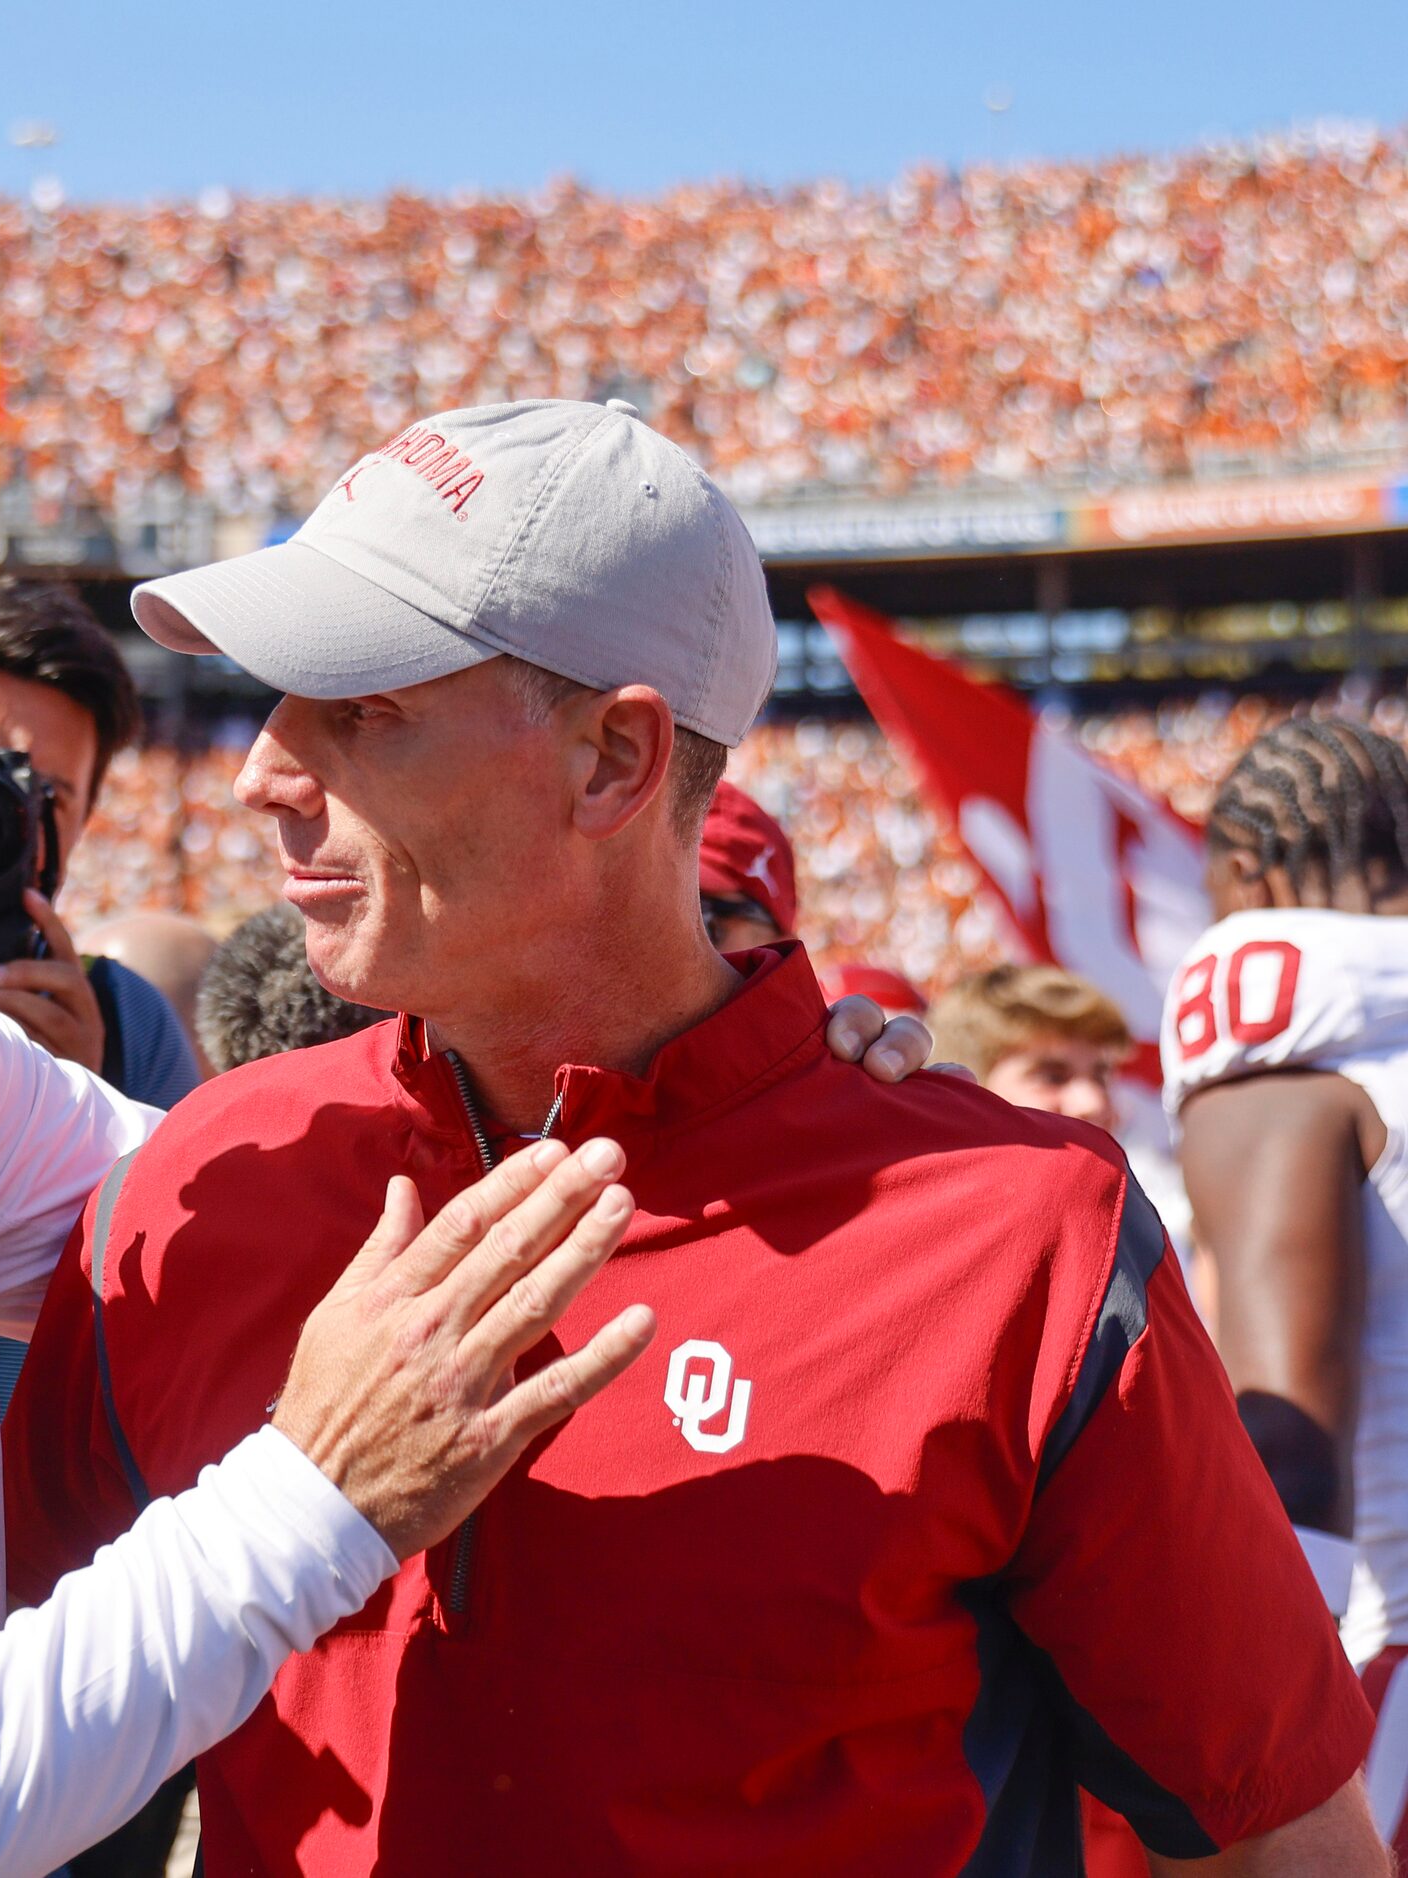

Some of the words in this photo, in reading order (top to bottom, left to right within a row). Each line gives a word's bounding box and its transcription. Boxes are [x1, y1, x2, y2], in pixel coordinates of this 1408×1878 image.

[376, 426, 485, 513] HOMA
[1175, 940, 1301, 1062] 80
[663, 1338, 752, 1454] OU
